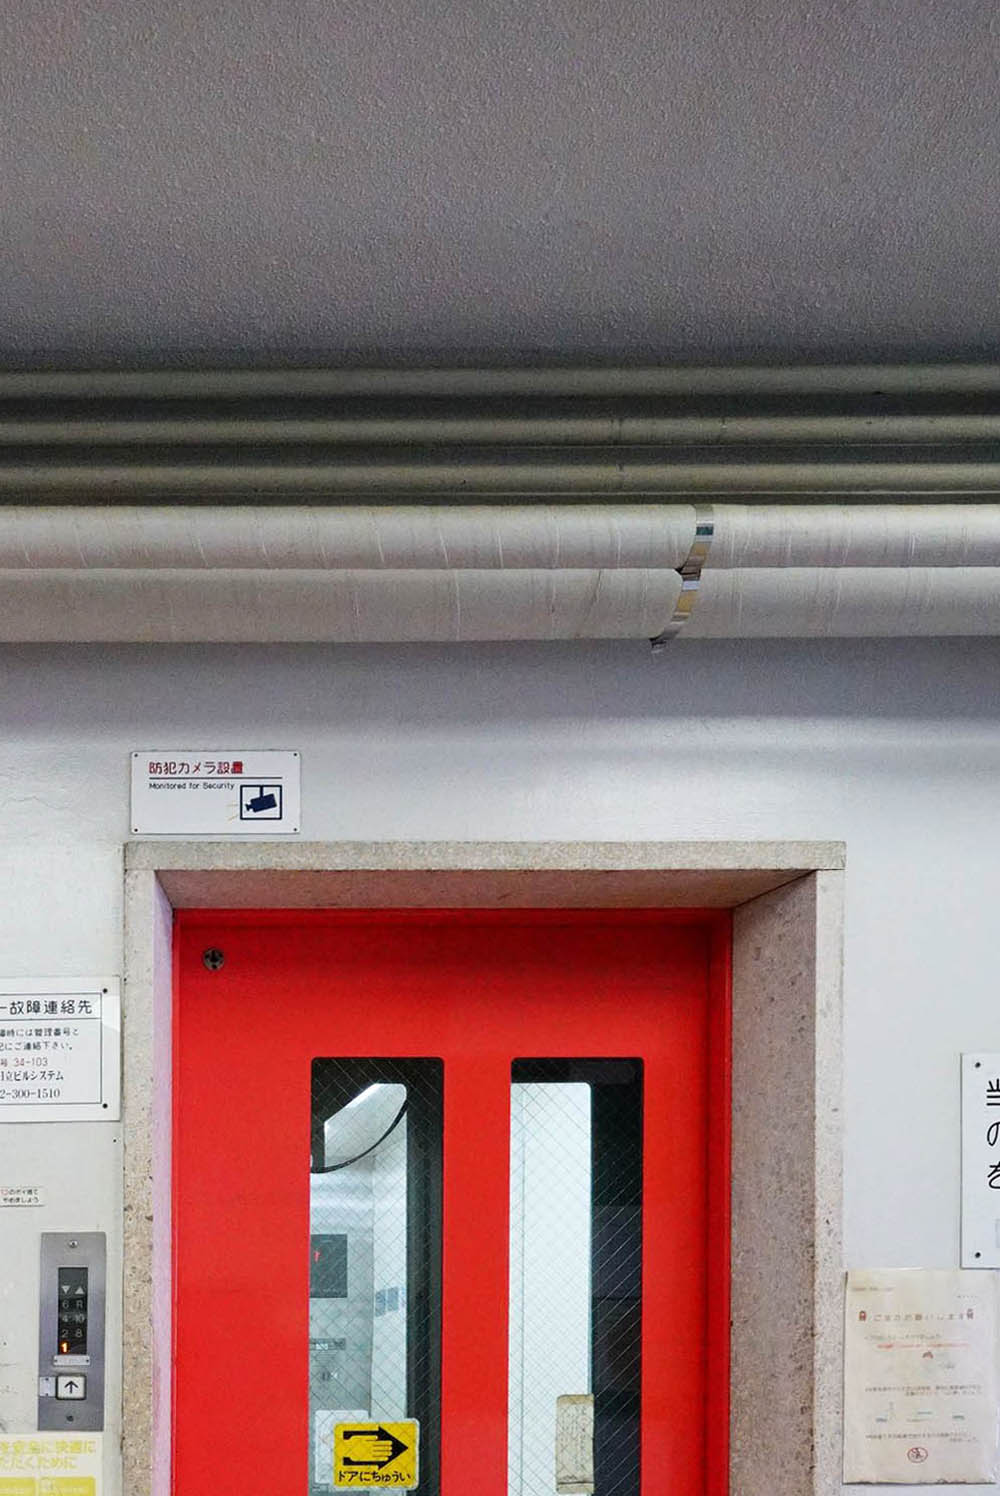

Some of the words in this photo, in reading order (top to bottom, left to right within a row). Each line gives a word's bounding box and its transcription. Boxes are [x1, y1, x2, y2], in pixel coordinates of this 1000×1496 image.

[149, 761, 243, 775] 防犯カメラ設置
[149, 782, 187, 790] Monitored
[189, 782, 199, 790] for
[202, 782, 235, 791] Security
[13, 1058, 49, 1067] 34-103
[61, 1343, 68, 1353] 1
[338, 1470, 411, 1482] ドアにちゅうい
